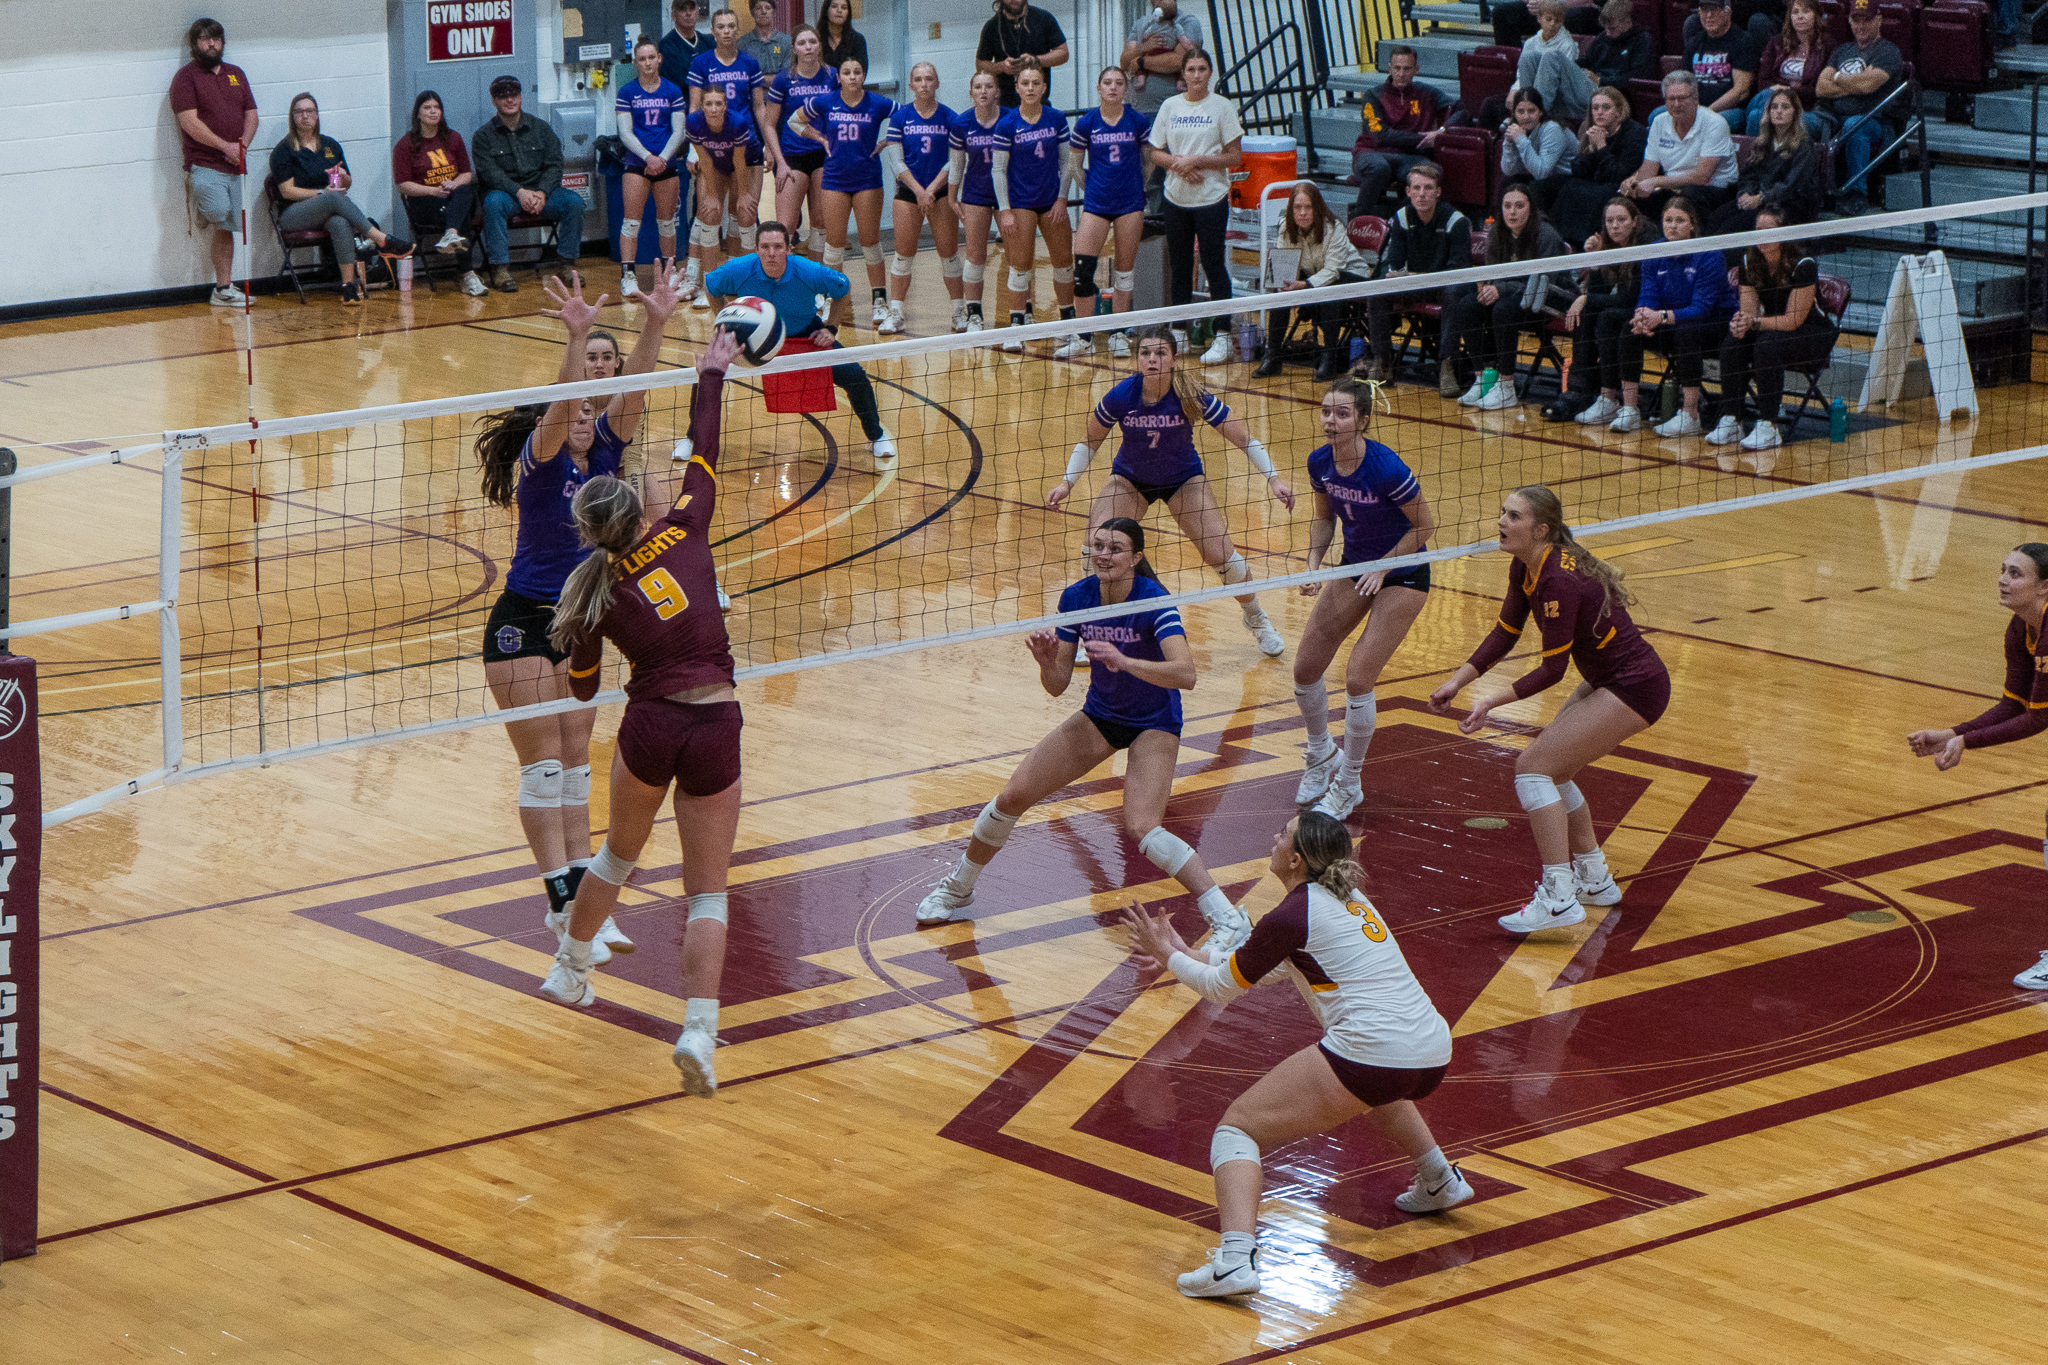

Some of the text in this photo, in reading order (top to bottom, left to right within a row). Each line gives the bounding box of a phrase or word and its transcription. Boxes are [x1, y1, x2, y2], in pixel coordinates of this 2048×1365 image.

[430, 3, 510, 24] GYM SHOES
[447, 27, 494, 55] ONLY
[708, 72, 749, 82] CARROLL
[726, 83, 735, 99] 6
[789, 85, 831, 96] CARROLL
[632, 99, 670, 108] CARROLL
[644, 109, 660, 126] 17
[829, 112, 872, 123] CARROLL
[838, 124, 859, 140] 20
[903, 125, 948, 135] CARROLL
[1014, 127, 1057, 143] CARROLL
[1091, 132, 1135, 143] CARROLL
[921, 137, 932, 153] 3
[1034, 141, 1044, 158] 4
[427, 149, 449, 168] N
[1109, 145, 1120, 162] 2
[427, 165, 456, 178] SPORTS
[561, 177, 586, 186] DANGER
[1123, 415, 1184, 428] CARROLL
[1147, 430, 1160, 448] 7
[1344, 503, 1354, 520] 1
[637, 567, 689, 620] 9
[1544, 601, 1559, 618] 12
[1080, 624, 1141, 643] CARROLL
[1346, 901, 1387, 942] 3
